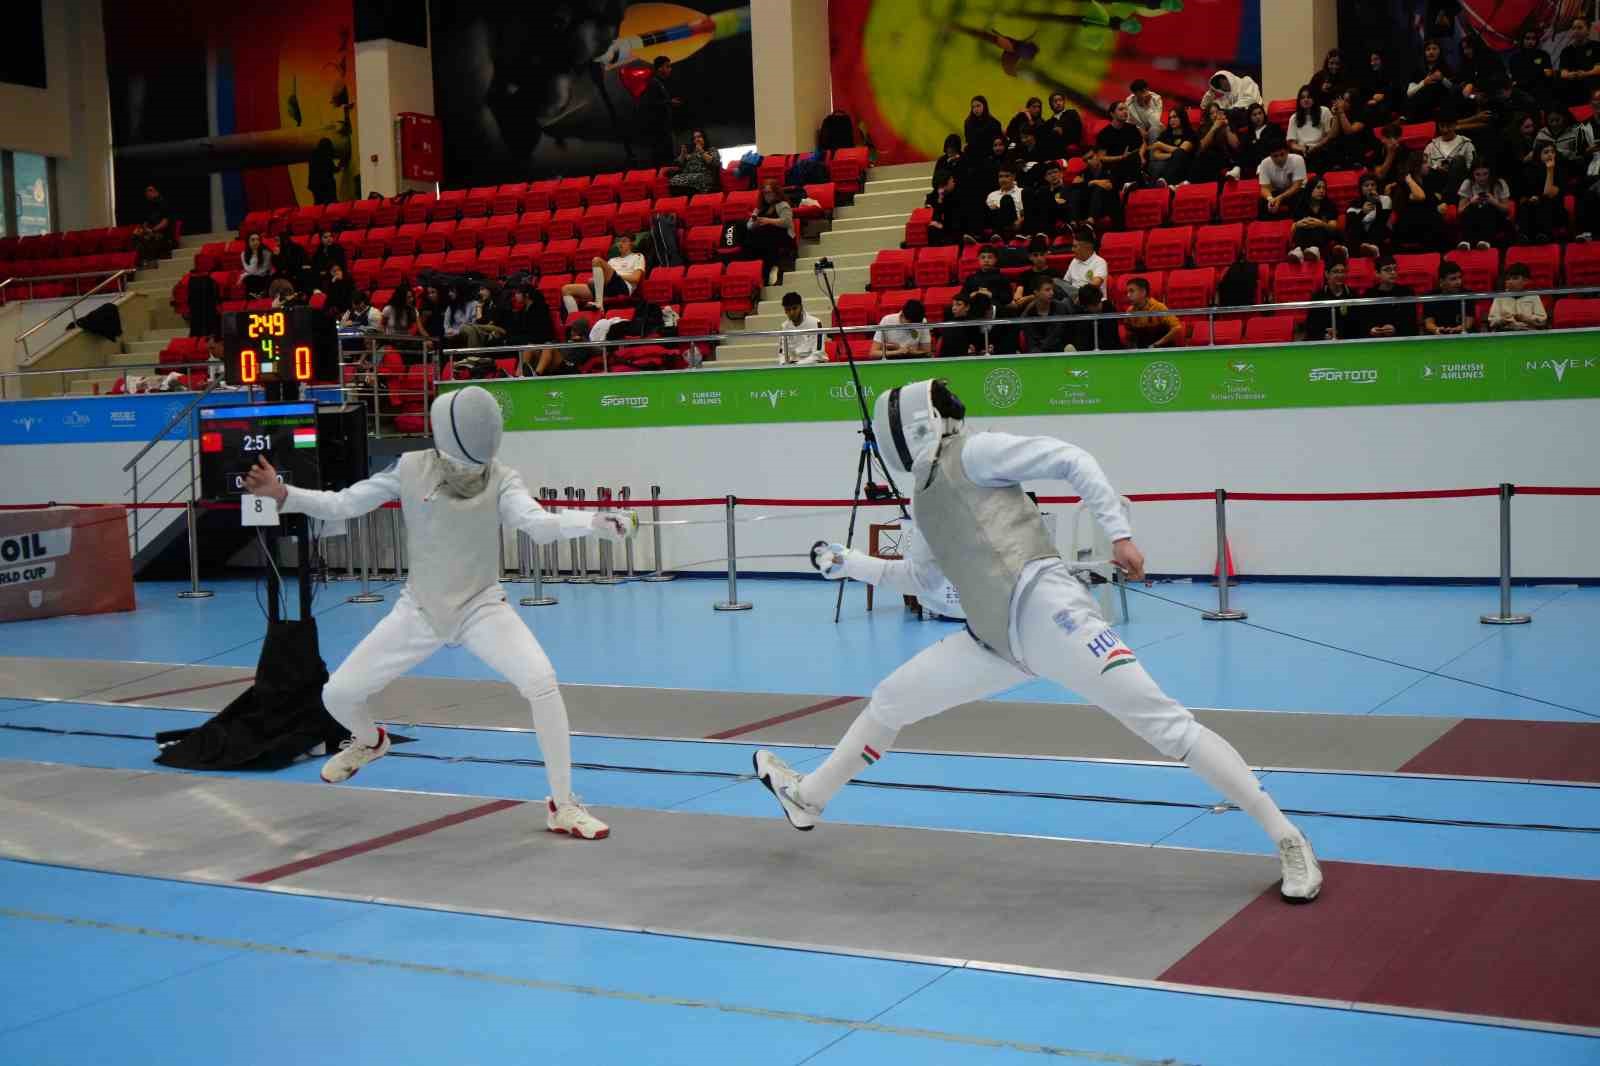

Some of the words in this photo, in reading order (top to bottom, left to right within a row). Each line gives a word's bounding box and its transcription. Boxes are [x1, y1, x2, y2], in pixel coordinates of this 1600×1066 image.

[249, 312, 284, 337] 2:49
[241, 350, 256, 382] 0
[296, 347, 310, 379] 0
[1440, 363, 1485, 372] TURKISH
[1526, 359, 1595, 382] NAVEK
[1440, 370, 1485, 380] AIRLINES
[830, 381, 875, 400] GLOIA
[243, 435, 272, 451] 2:51
[255, 499, 263, 513] 8
[1, 533, 47, 562] OIL
[23, 566, 46, 580] CUP
